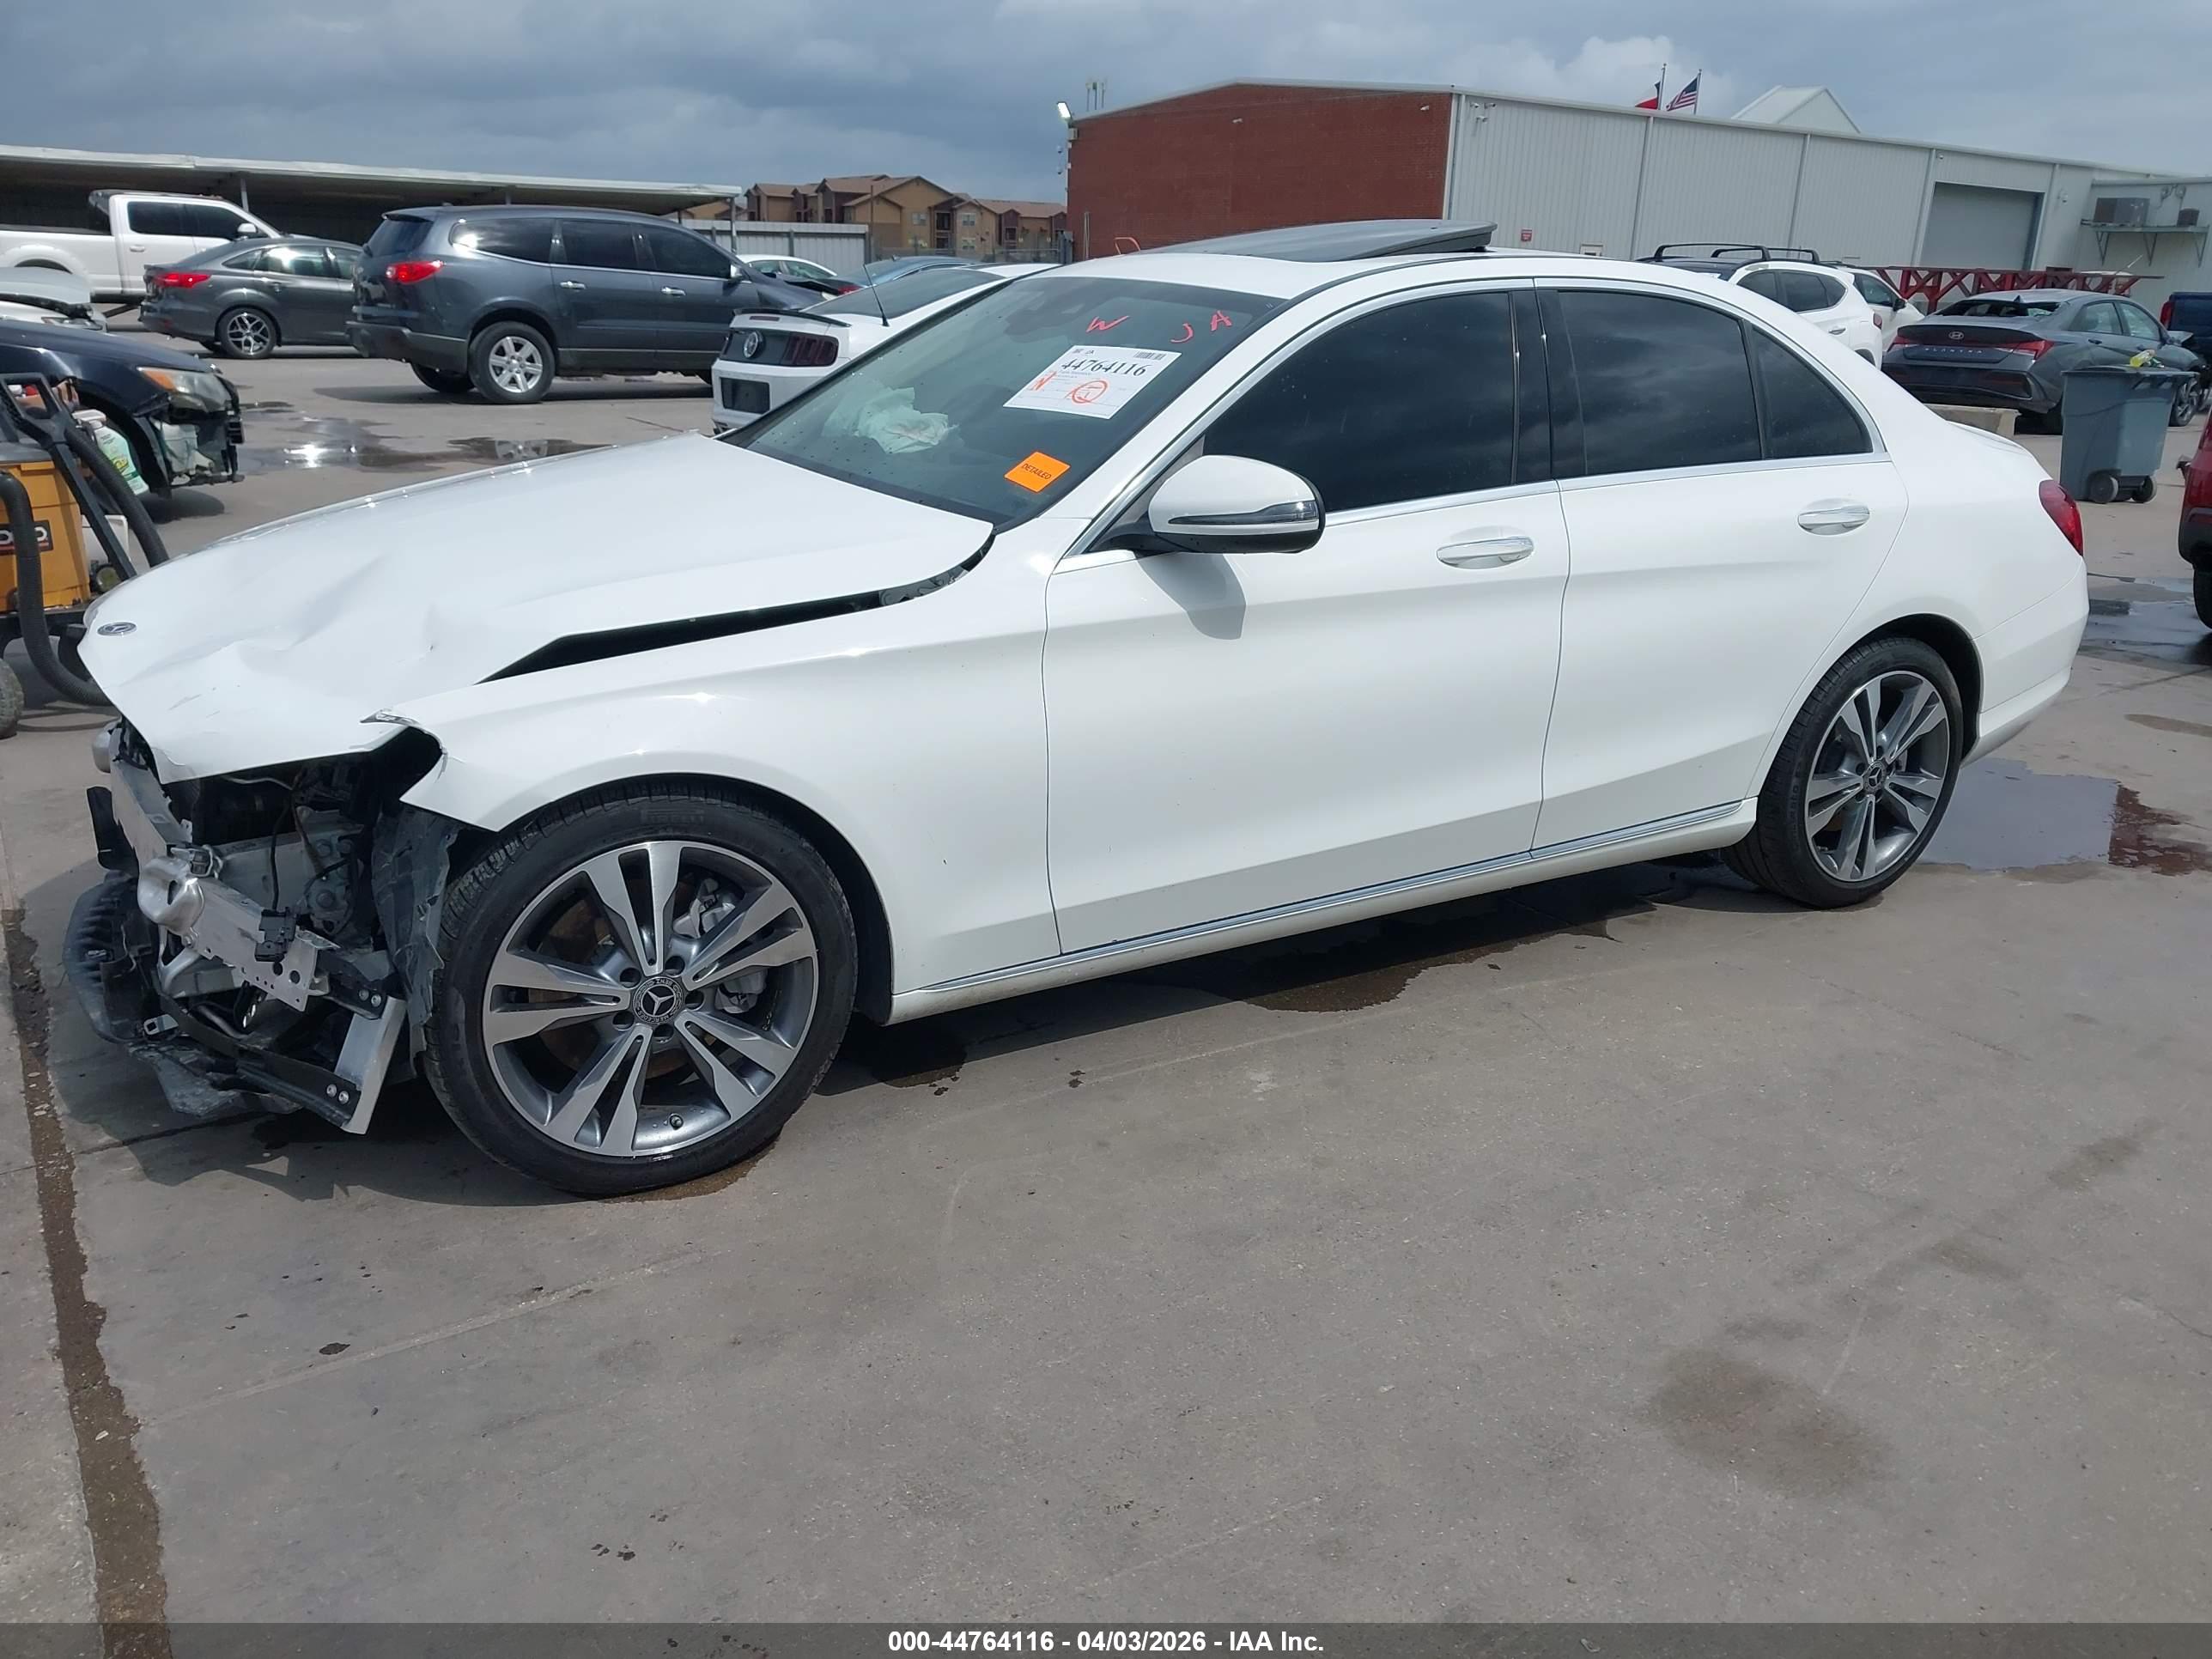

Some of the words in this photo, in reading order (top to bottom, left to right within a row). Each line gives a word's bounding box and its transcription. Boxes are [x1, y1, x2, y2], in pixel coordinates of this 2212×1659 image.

[1211, 310, 1232, 331] A
[1061, 357, 1150, 377] 44764116
[1022, 464, 1052, 479] DETAILED
[638, 1011, 670, 1023] MERCEDES
